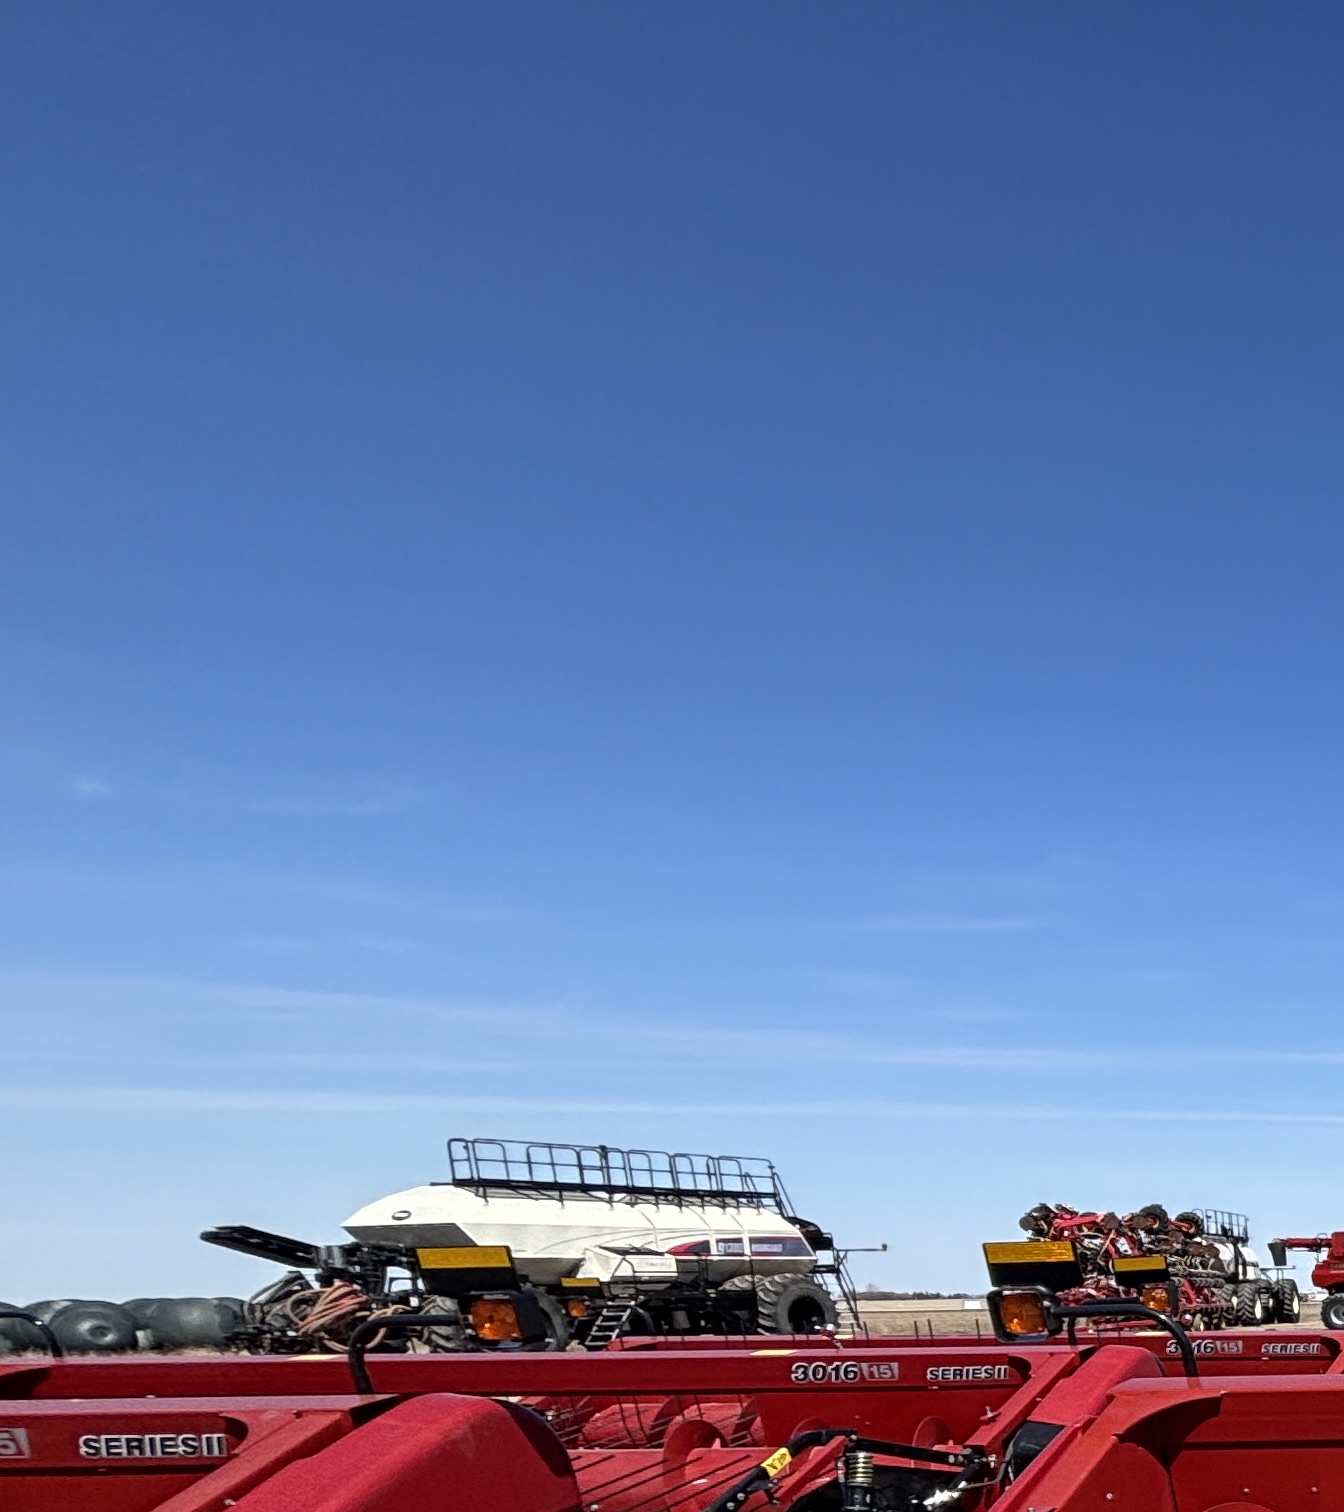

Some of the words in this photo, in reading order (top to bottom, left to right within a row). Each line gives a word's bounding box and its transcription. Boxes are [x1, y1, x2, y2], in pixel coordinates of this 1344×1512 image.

[1166, 1339, 1216, 1356] 316
[1222, 1342, 1238, 1353] 15
[791, 1361, 859, 1384] 3016
[870, 1364, 892, 1379] 15
